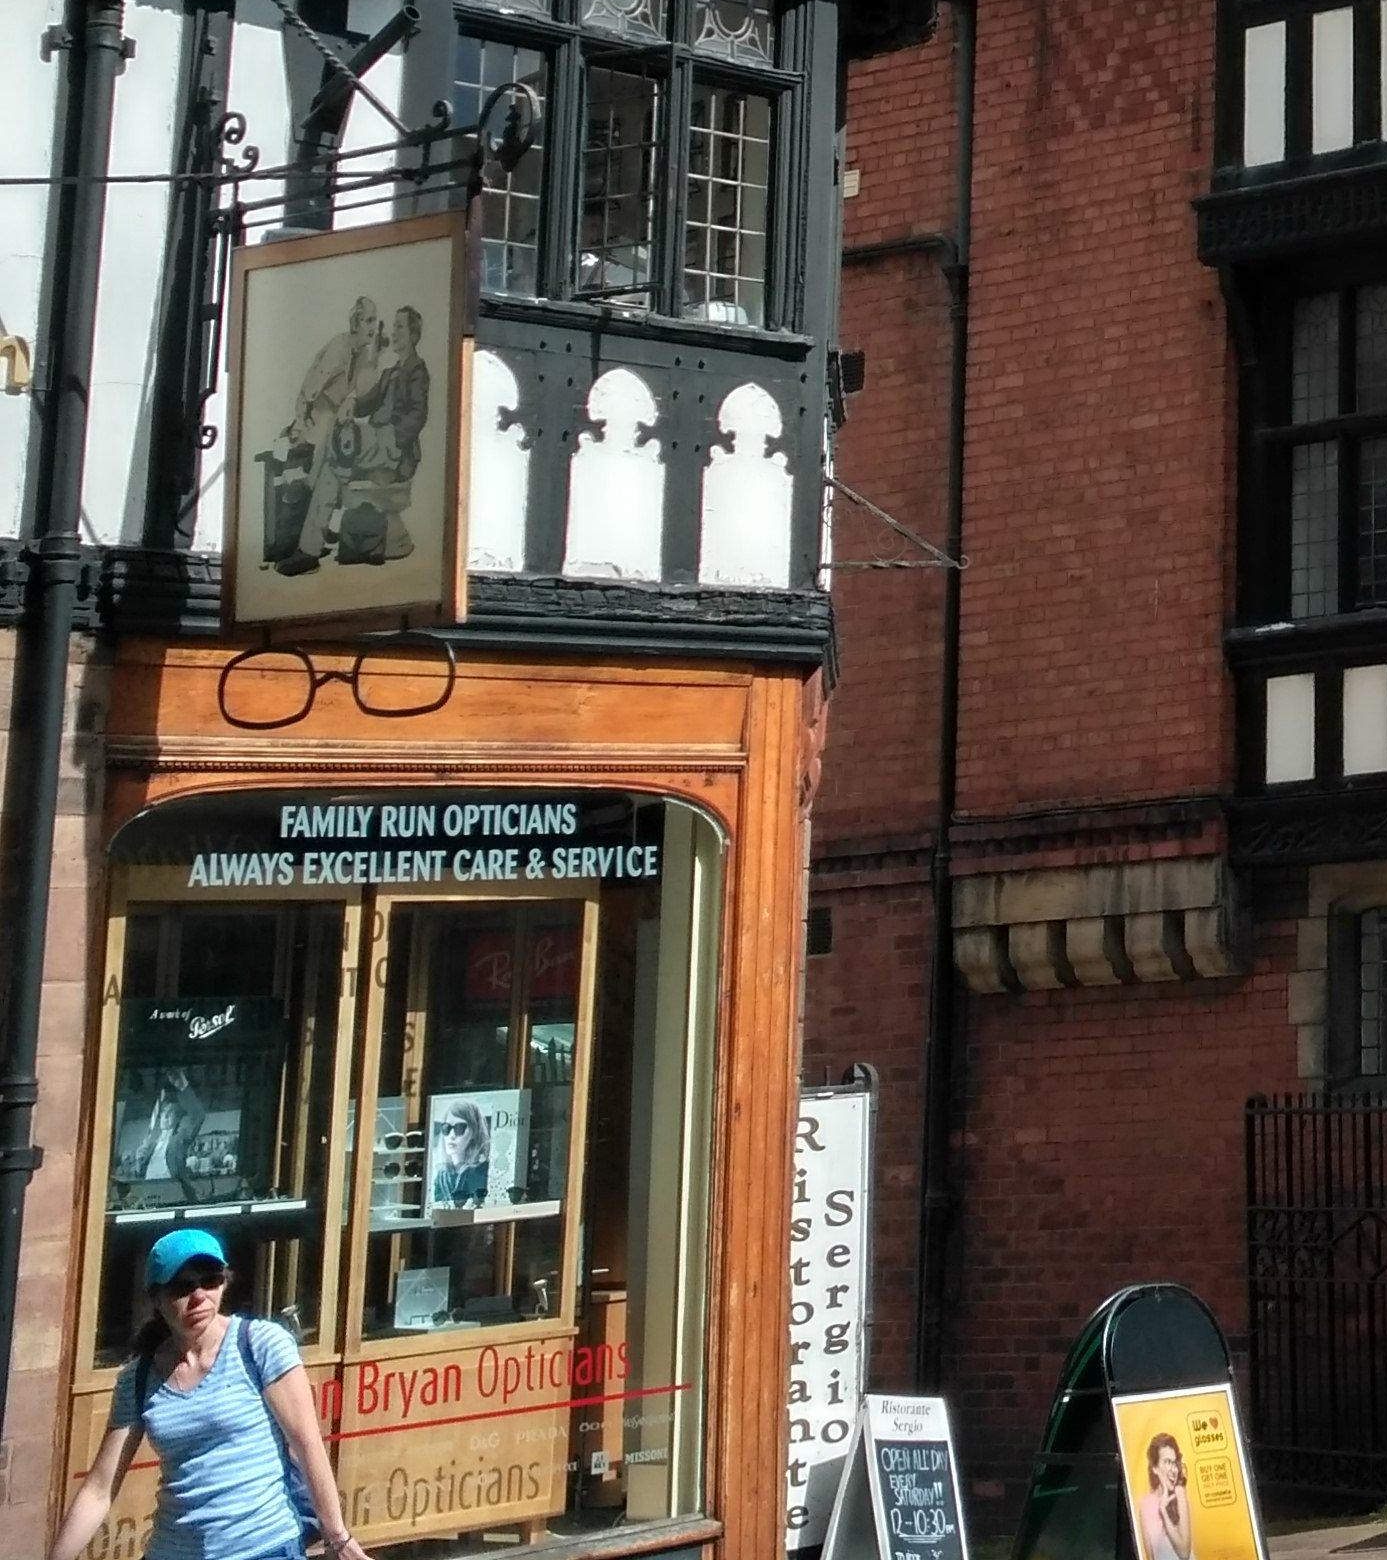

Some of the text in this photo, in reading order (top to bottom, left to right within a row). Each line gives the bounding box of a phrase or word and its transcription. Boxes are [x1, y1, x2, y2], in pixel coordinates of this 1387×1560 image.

[280, 803, 577, 838] FAMILY RUN OPTICIANS
[187, 845, 658, 887] ALWAYS EXCELLENT CARE & SERVICE
[495, 1110, 526, 1130] Dior
[820, 1188, 856, 1444] Sergio
[357, 1360, 462, 1418] Bryan
[477, 1341, 632, 1404] Opticians
[881, 1399, 931, 1416] Ristorante
[892, 1417, 923, 1435] Sergio
[1192, 1419, 1207, 1432] We
[1194, 1433, 1224, 1447] glasses
[625, 1448, 668, 1465] MISSONI
[881, 1447, 910, 1472] OPEN
[931, 1446, 949, 1472] DAY
[1213, 1462, 1226, 1472] ONE
[889, 1473, 916, 1490] EVERY
